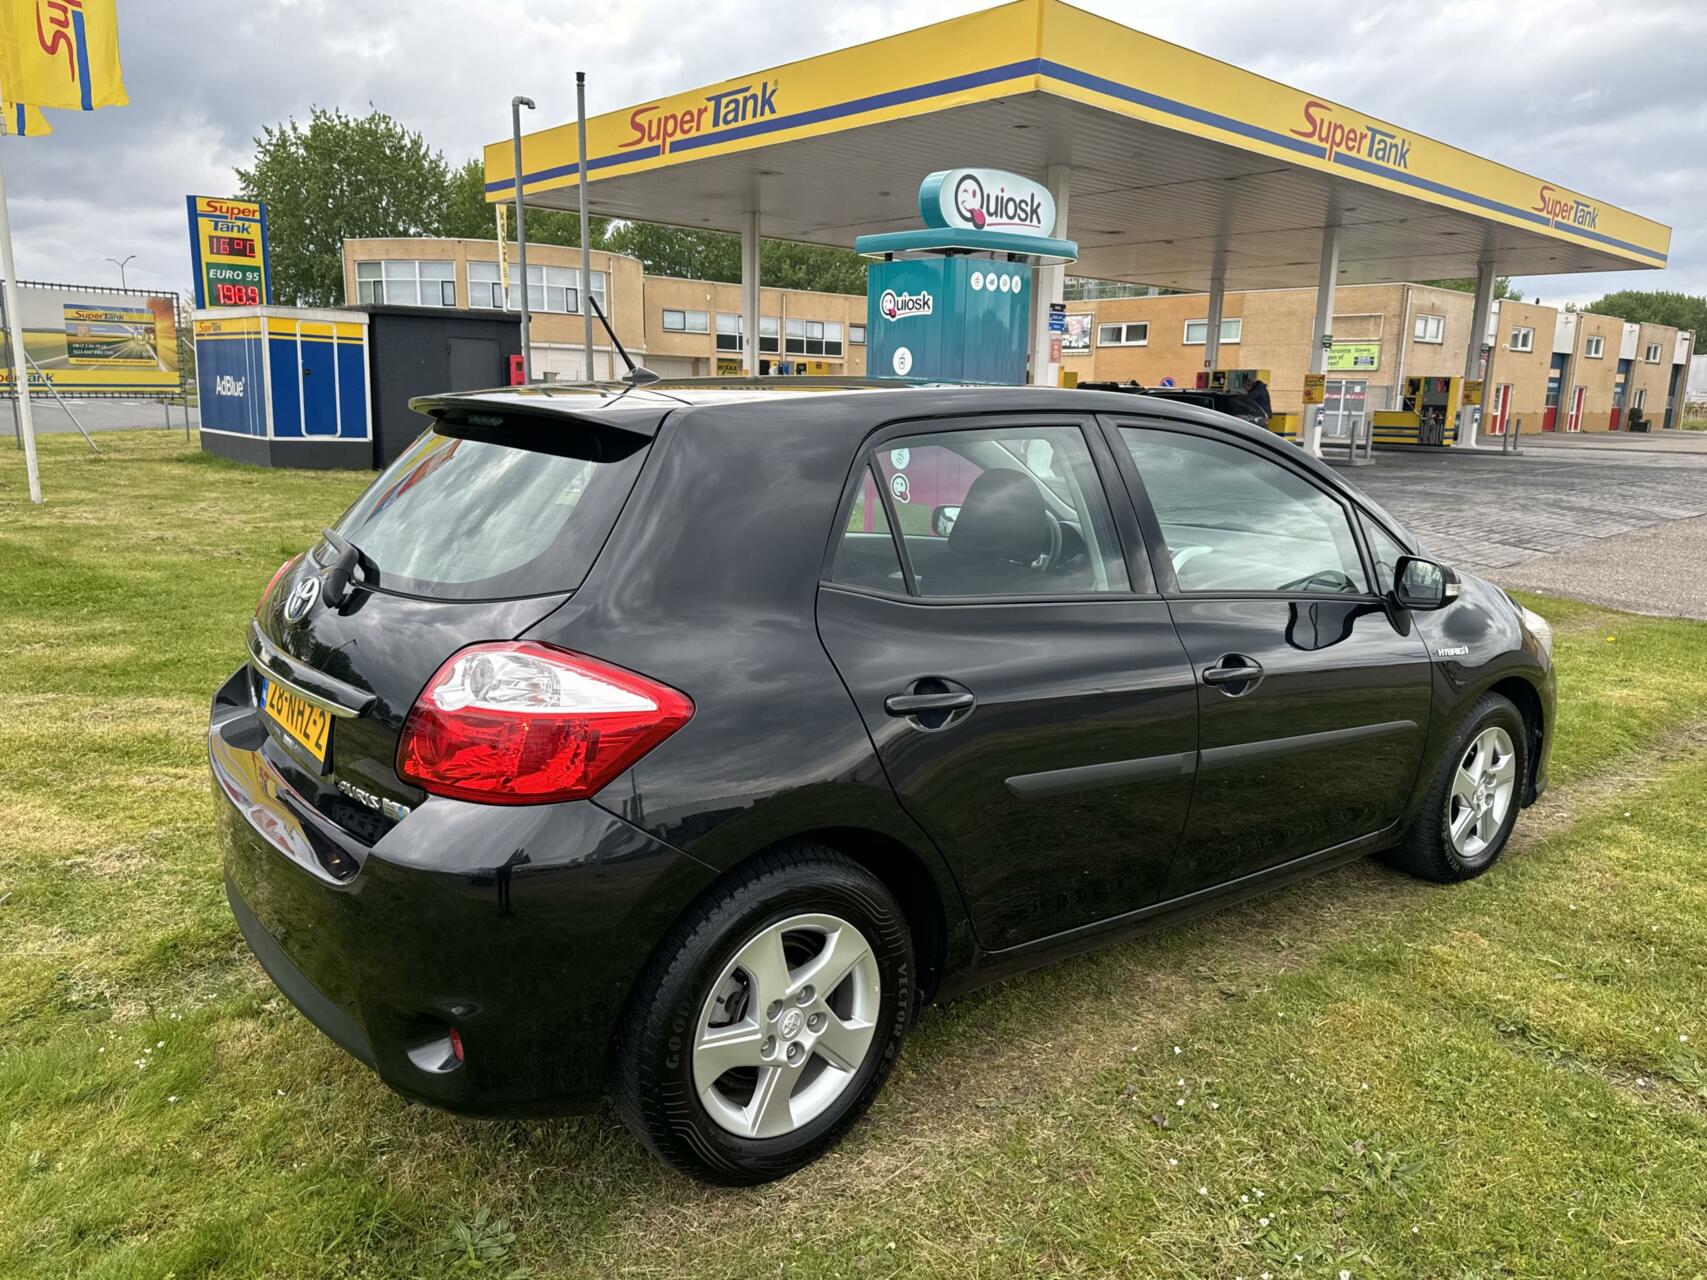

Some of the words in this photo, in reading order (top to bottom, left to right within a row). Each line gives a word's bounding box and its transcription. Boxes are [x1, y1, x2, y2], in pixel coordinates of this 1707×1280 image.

[36, 0, 82, 82] Su
[618, 82, 778, 155] SuperTank
[1289, 100, 1410, 169] SuperTank
[197, 200, 259, 220] Super
[955, 174, 1041, 230] Quiosk
[1531, 185, 1598, 229] SuperTank
[208, 220, 251, 234] Tank
[209, 269, 242, 279] EURO
[246, 272, 260, 281] 95
[217, 284, 259, 305] 198.9
[881, 292, 931, 318] Quiosk
[75, 311, 125, 321] SuperTank
[215, 375, 244, 397] AdBlue
[893, 962, 909, 1037] VECTOR
